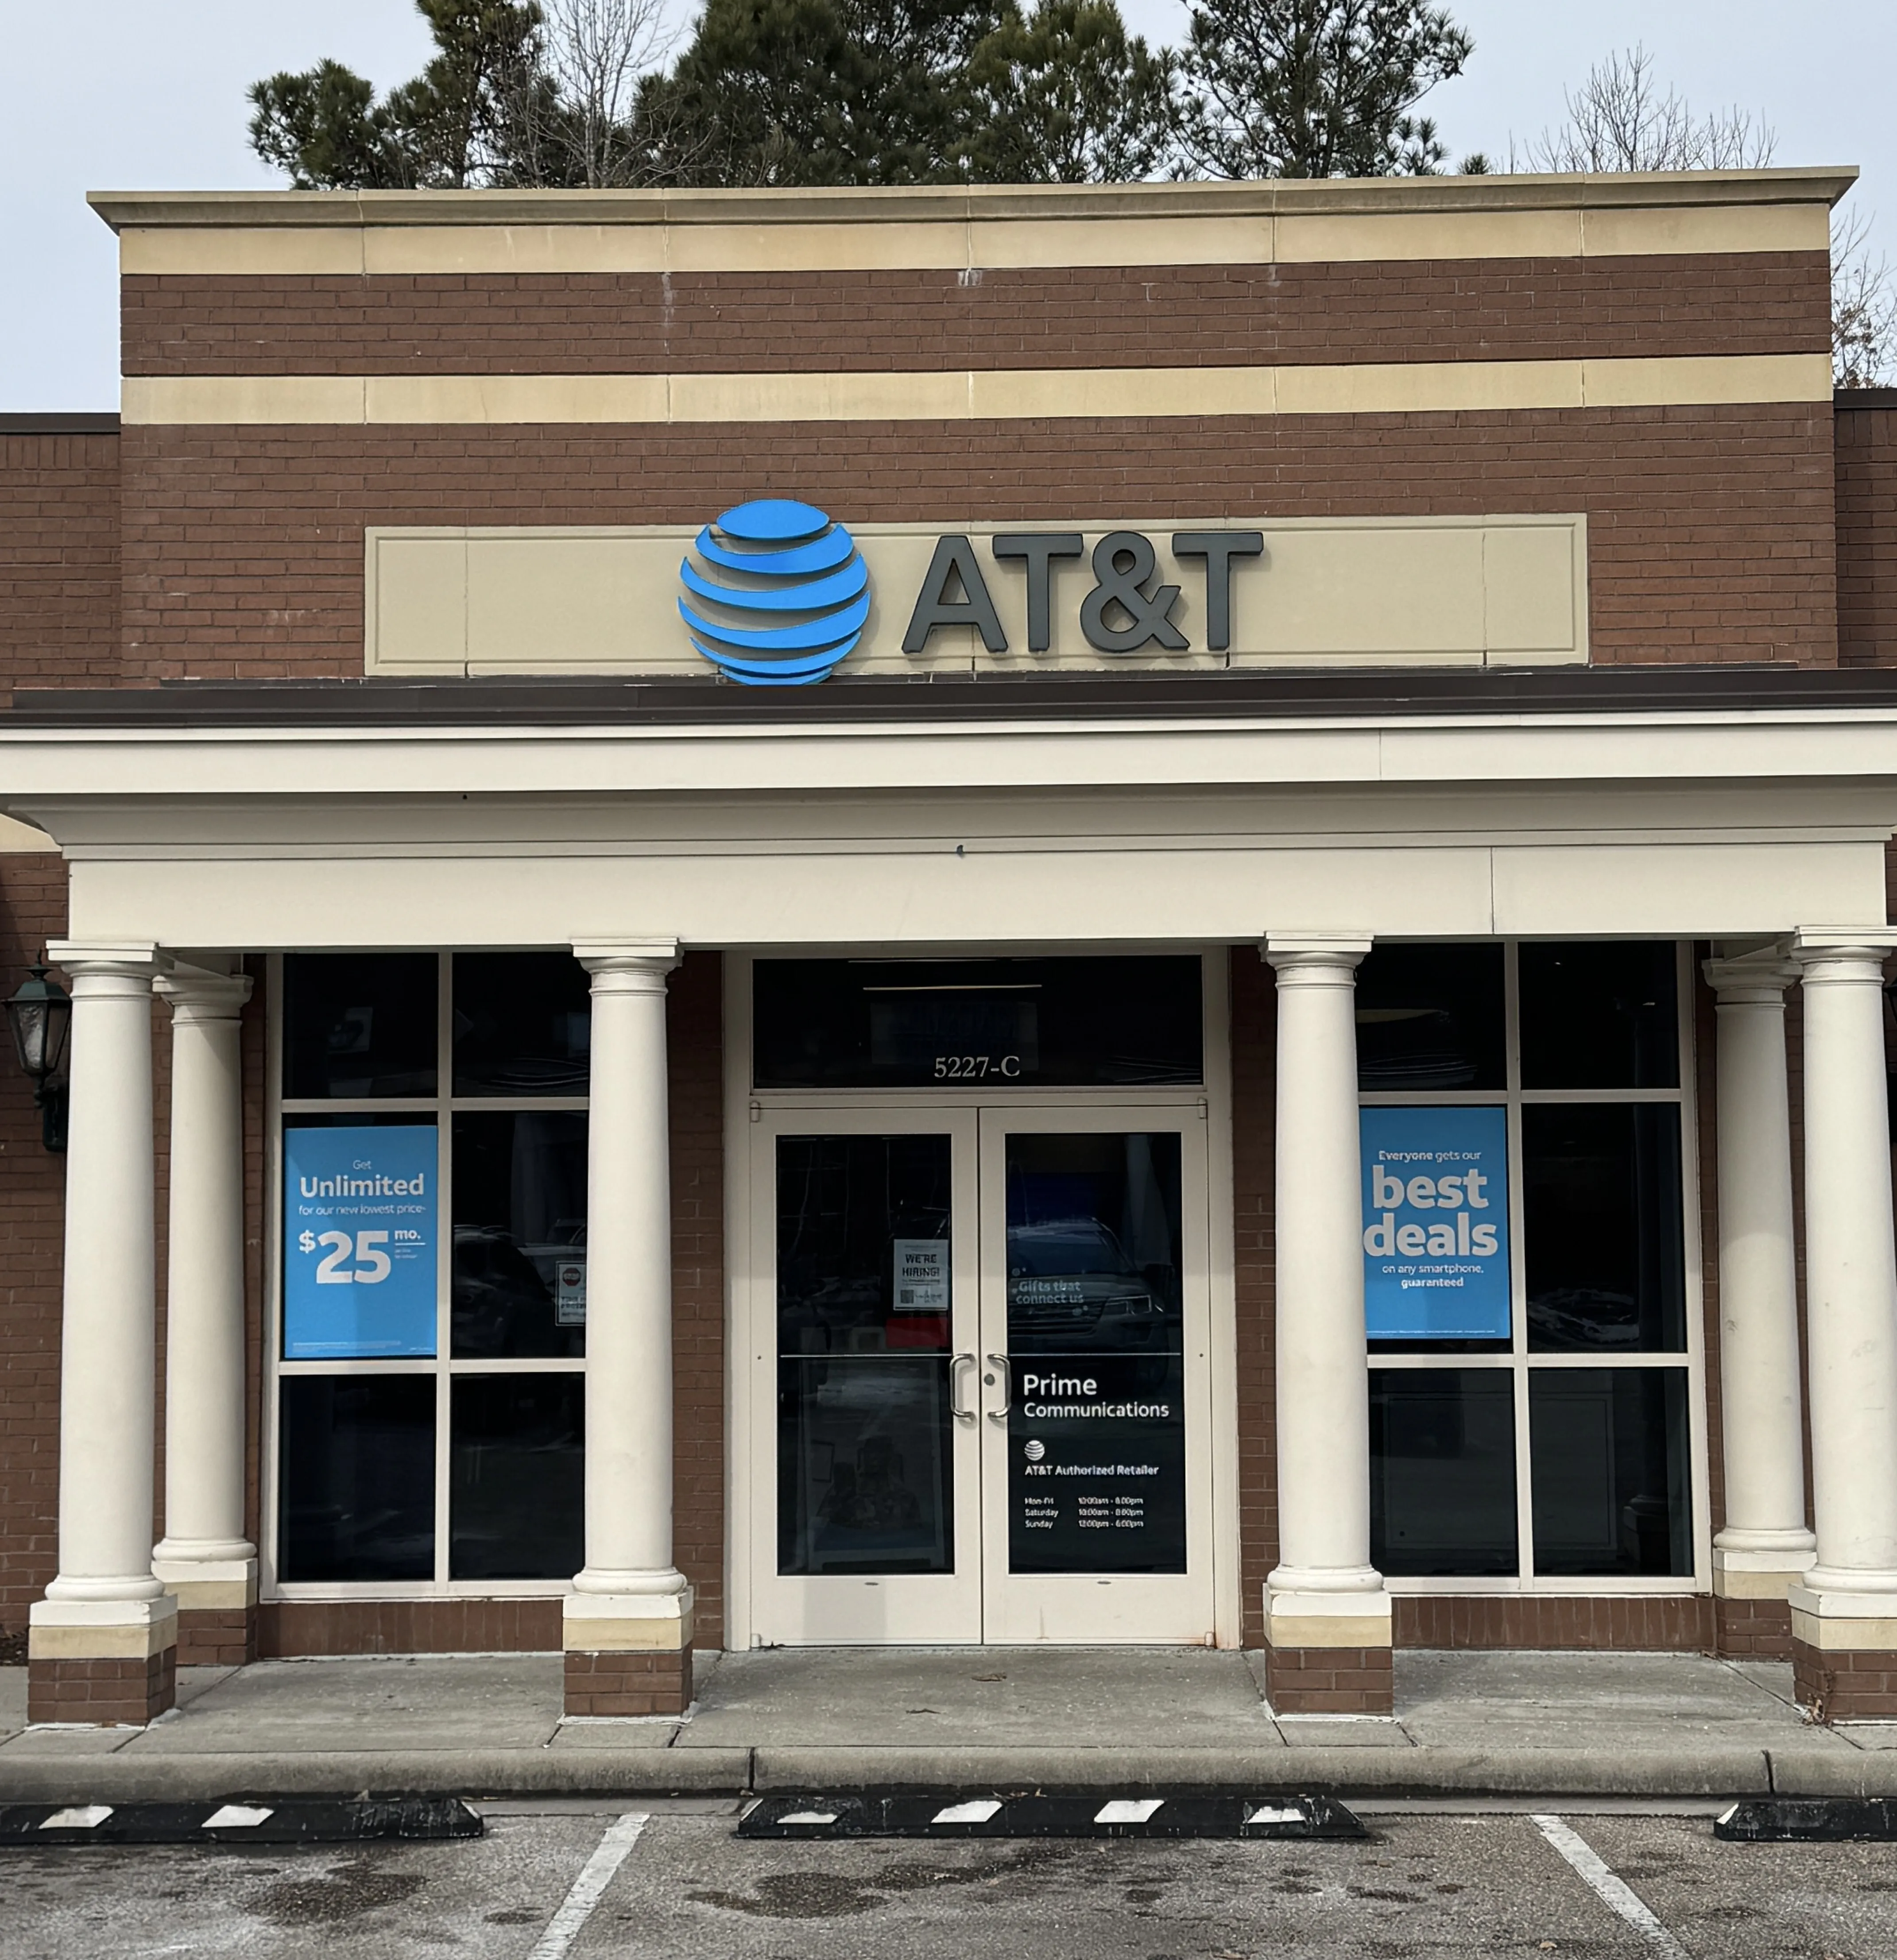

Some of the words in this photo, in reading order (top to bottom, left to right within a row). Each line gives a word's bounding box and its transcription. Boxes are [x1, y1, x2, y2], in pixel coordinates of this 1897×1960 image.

[902, 531, 1264, 654] AT&T
[933, 1055, 1021, 1078] 5227-C
[1378, 1150, 1433, 1163] Everyone
[1435, 1151, 1460, 1163] gets
[352, 1160, 372, 1170] Get
[300, 1173, 424, 1198] Unlimited
[1373, 1165, 1489, 1209] best
[298, 1205, 313, 1215] for
[360, 1204, 395, 1215] lowest
[394, 1230, 421, 1240] mo.
[1363, 1212, 1499, 1257] deals
[902, 1267, 940, 1277] HIRING!
[1398, 1265, 1417, 1276] any
[1018, 1280, 1051, 1292] Gifts
[1053, 1279, 1081, 1291] that
[1401, 1276, 1464, 1289] guaranteed
[1015, 1293, 1067, 1304] connect
[1069, 1294, 1084, 1304] us
[1023, 1373, 1097, 1396] Prime
[1024, 1401, 1169, 1418] Communications
[1025, 1465, 1053, 1476] AT&T
[1055, 1465, 1115, 1476] Authorized
[1117, 1465, 1159, 1475] Retailer
[1025, 1508, 1059, 1518] Saturday
[1025, 1519, 1053, 1529] Sunday
